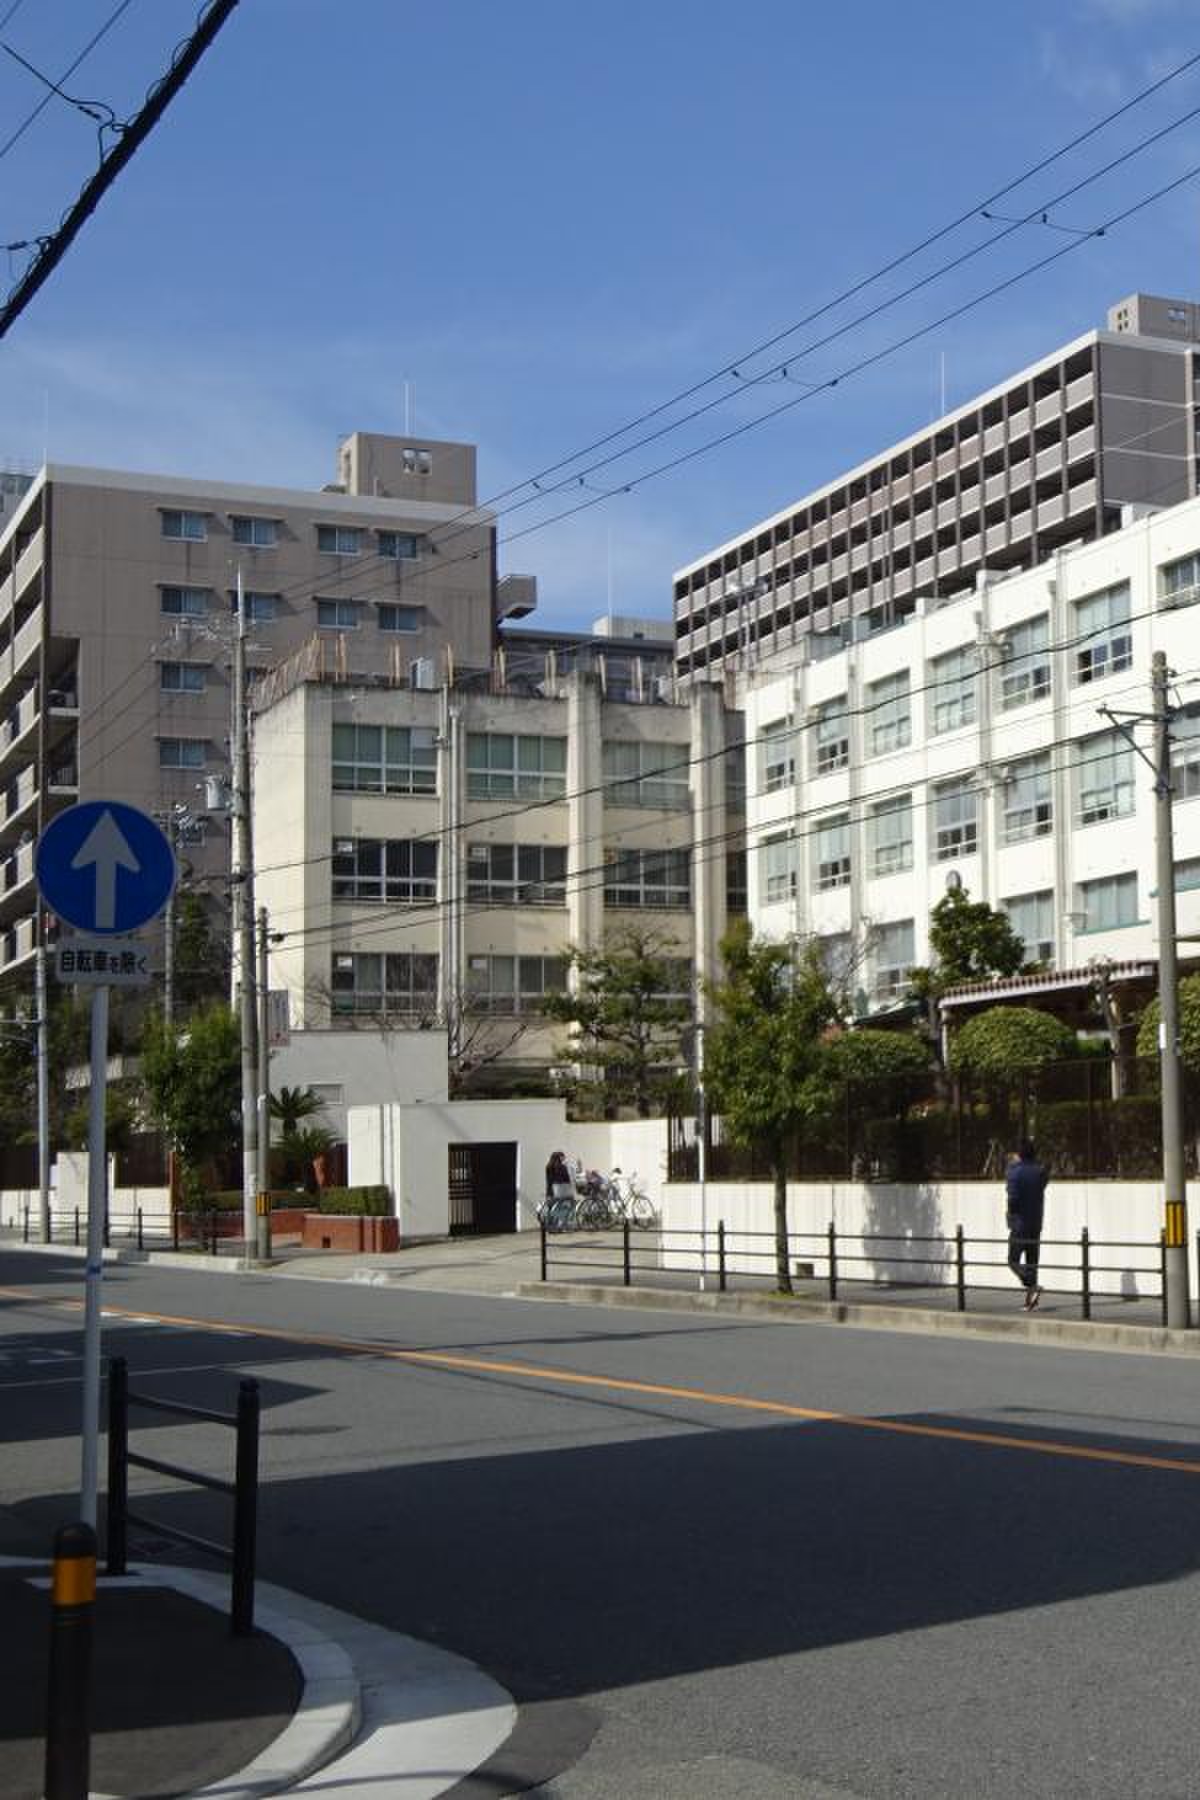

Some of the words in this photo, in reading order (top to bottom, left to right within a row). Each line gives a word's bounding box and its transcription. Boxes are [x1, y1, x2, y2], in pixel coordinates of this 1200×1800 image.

[61, 949, 147, 975] 自転車を除く
